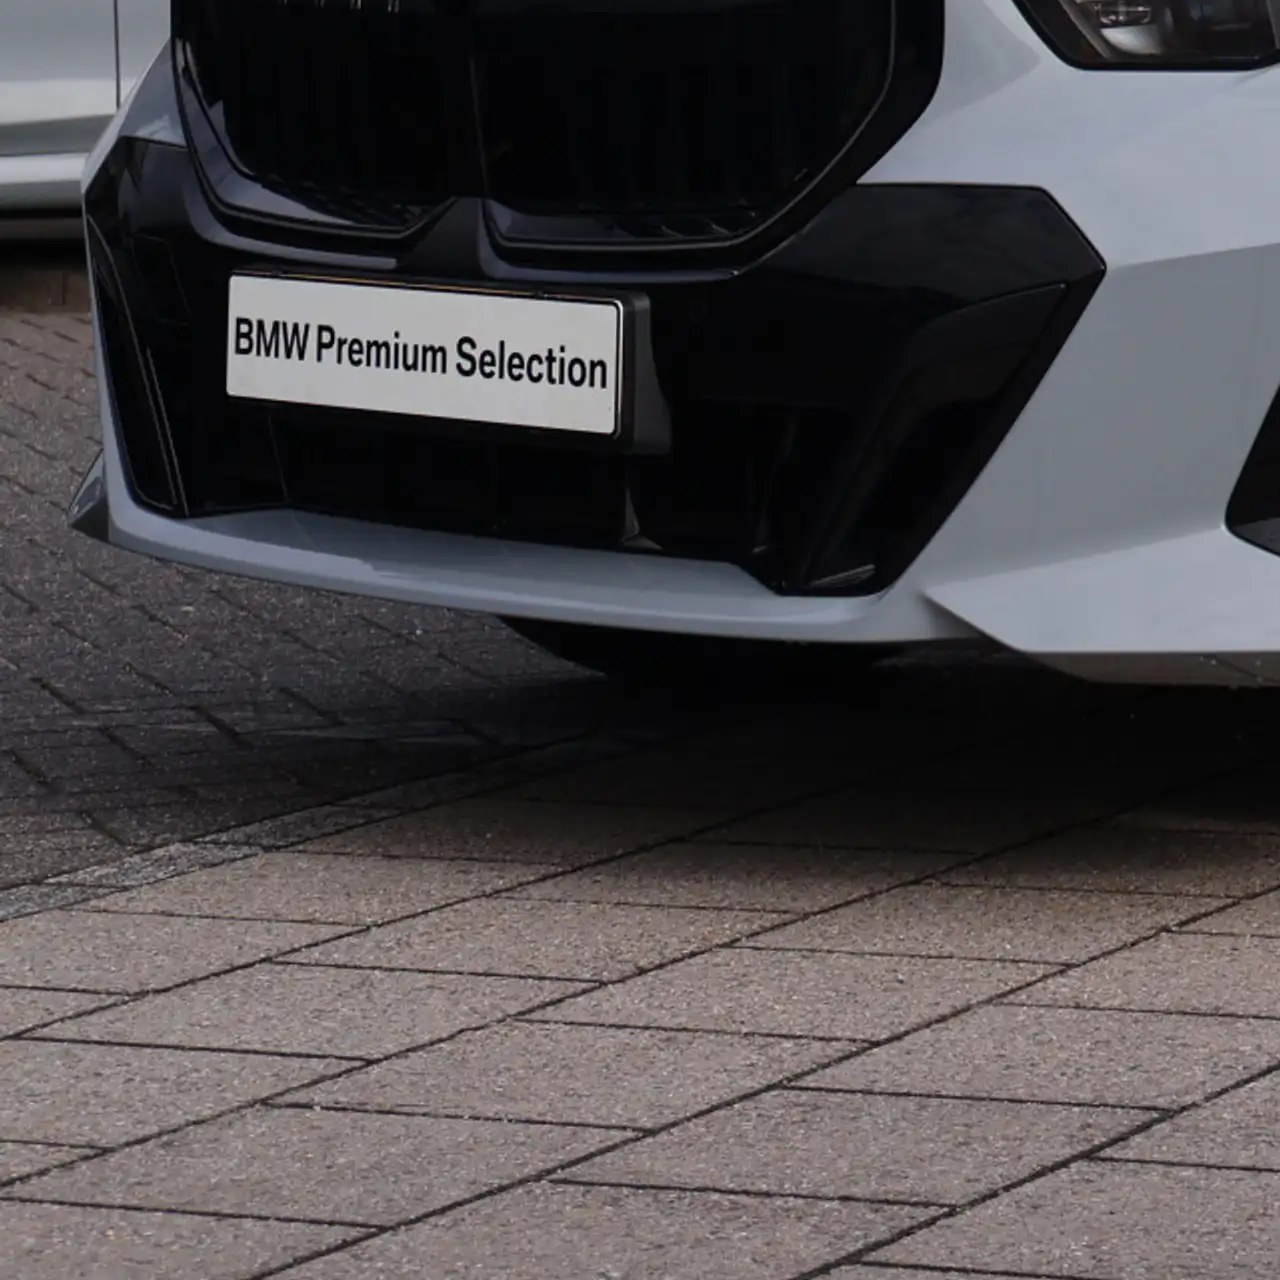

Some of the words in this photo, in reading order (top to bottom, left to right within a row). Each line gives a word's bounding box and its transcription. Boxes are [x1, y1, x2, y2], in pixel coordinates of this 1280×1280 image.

[235, 316, 310, 361] BMW
[316, 324, 448, 374] Premium
[456, 336, 607, 389] Selection
